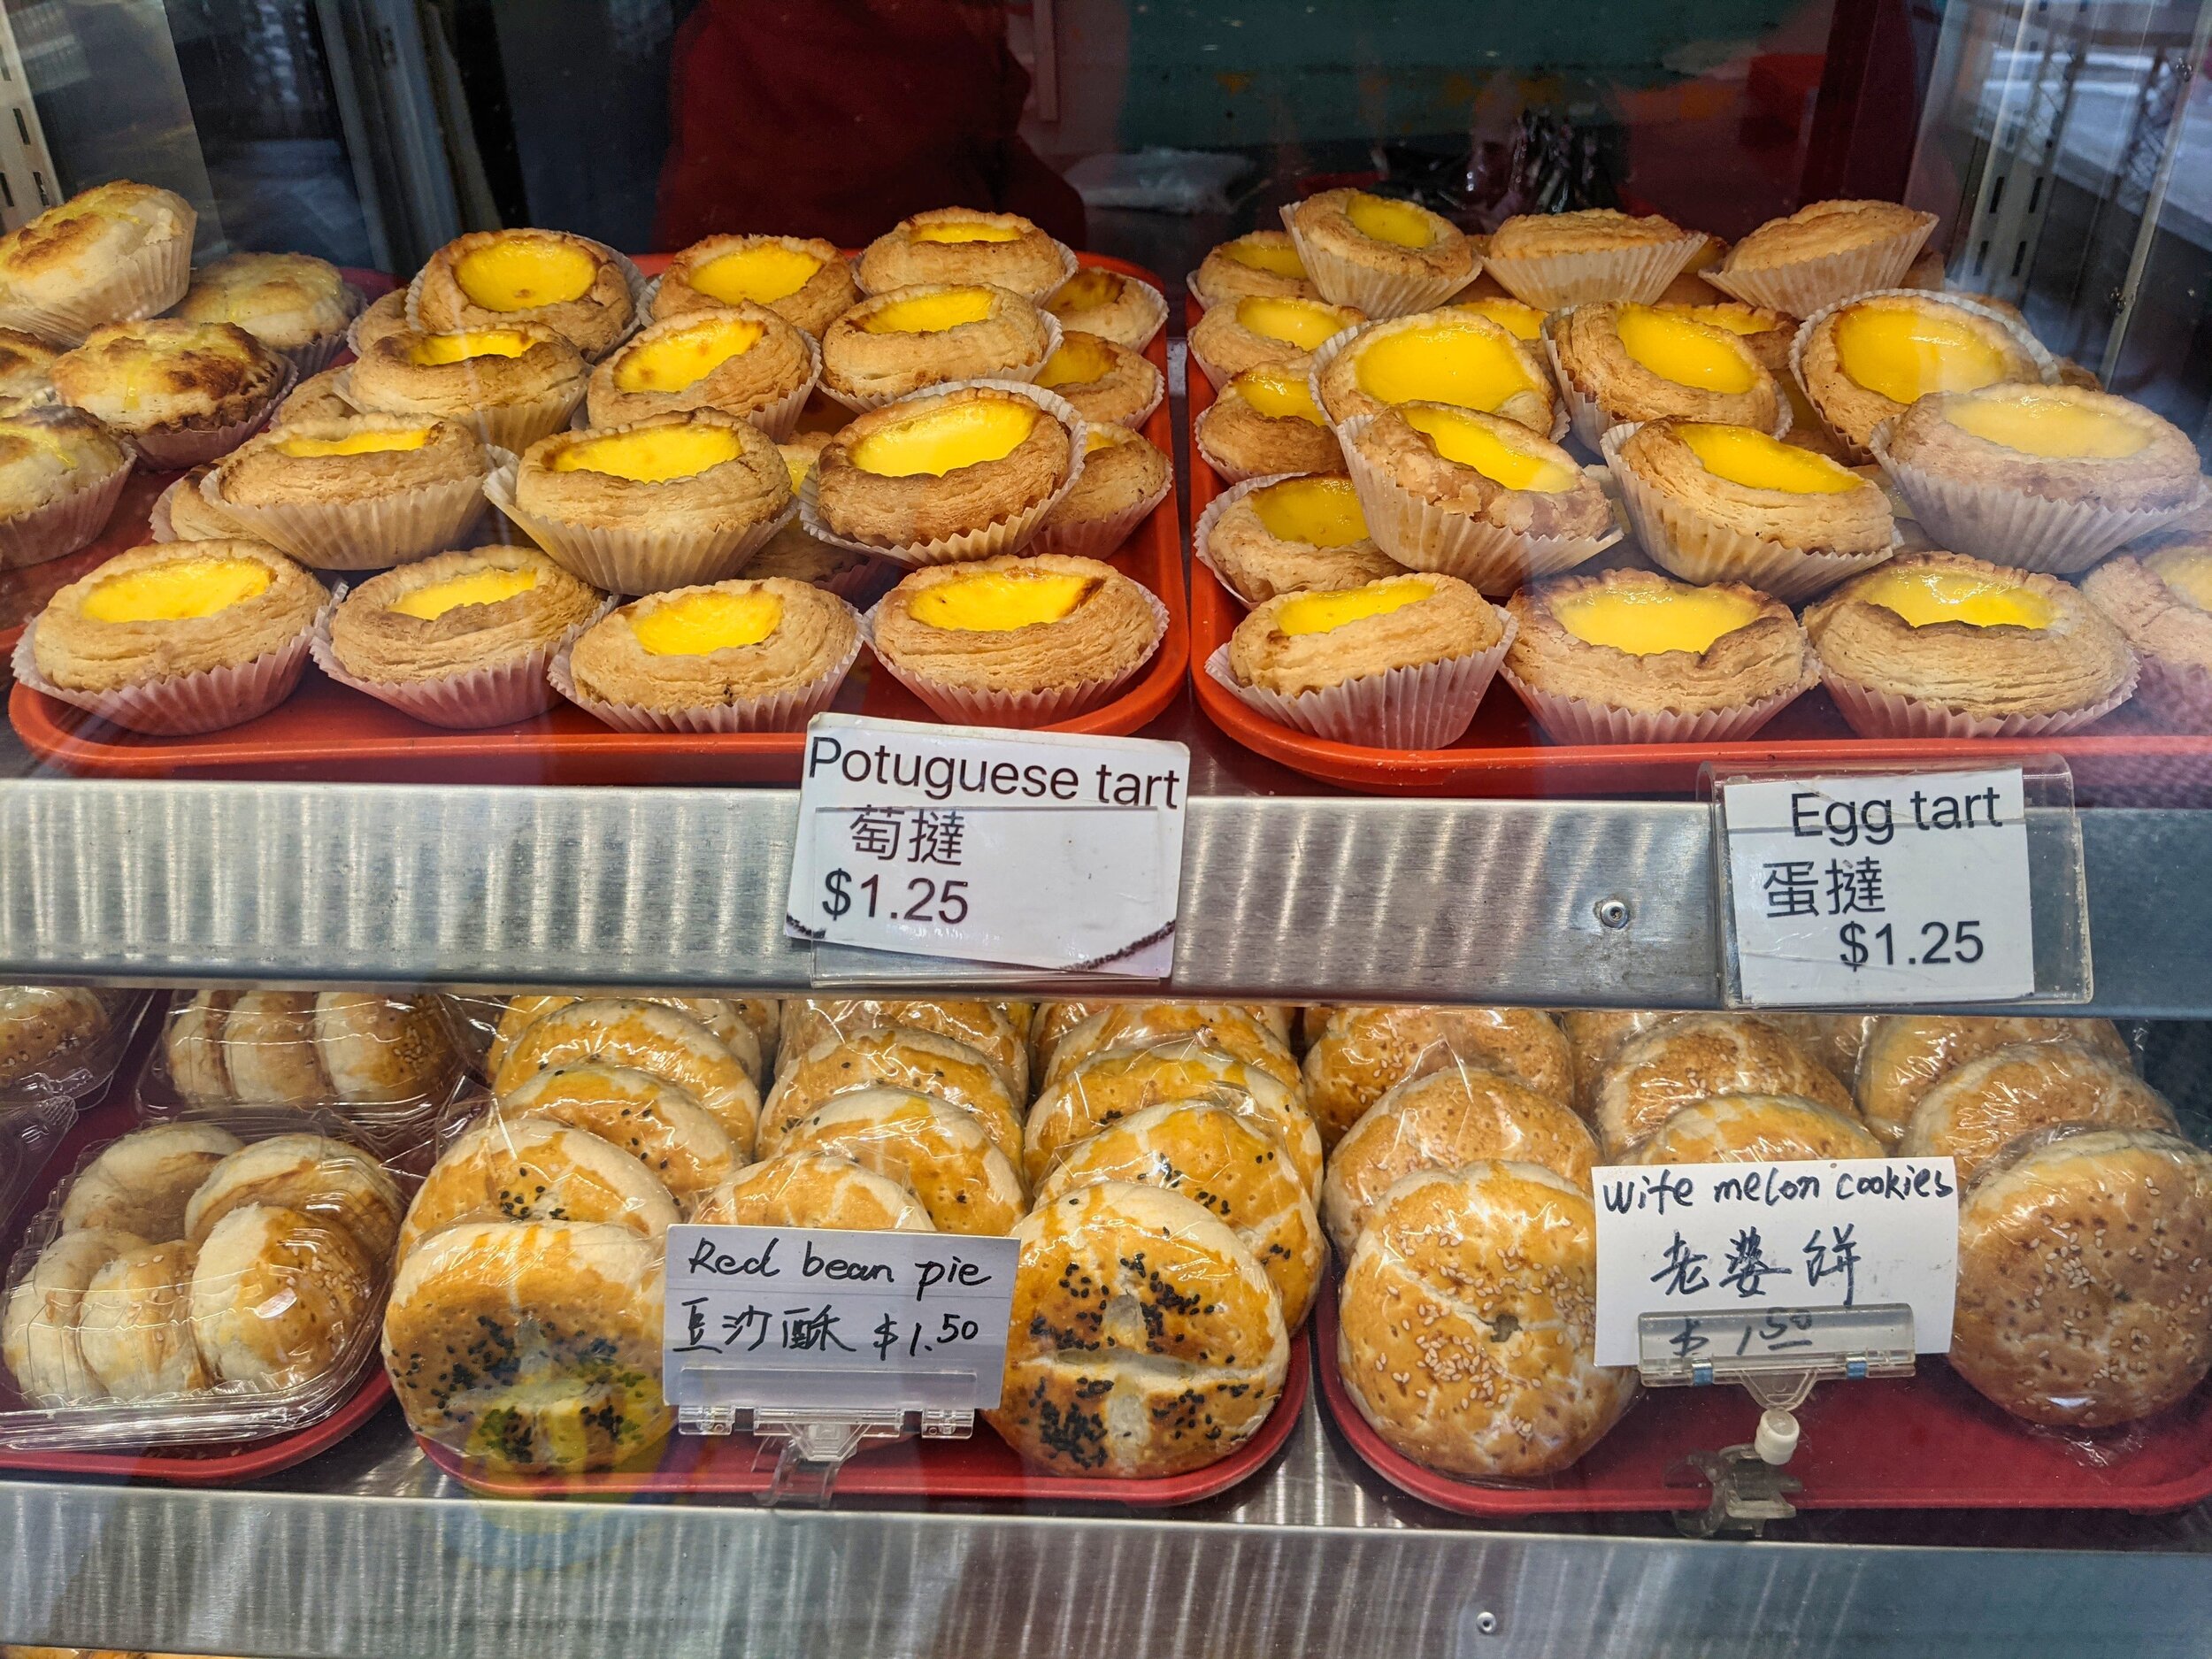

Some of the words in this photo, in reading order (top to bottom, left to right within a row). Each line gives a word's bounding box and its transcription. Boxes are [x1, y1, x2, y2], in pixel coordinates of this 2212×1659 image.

[809, 736, 1079, 800] Potuguese
[1095, 764, 1180, 809] tart
[849, 804, 964, 865] 萄撻
[1791, 792, 1894, 847] Egg
[1909, 787, 2003, 831] tart
[822, 868, 969, 924] $1.25
[1763, 856, 1886, 918] 蛋撻
[1839, 920, 1984, 972] $1.25
[1714, 1167, 1820, 1207] melon
[1836, 1164, 1954, 1200] cookies
[688, 1238, 780, 1277] Red
[803, 1240, 894, 1282] bean
[915, 1257, 992, 1301] pie
[672, 1298, 856, 1355] 豆沙酥
[873, 1313, 979, 1360] $1.50
